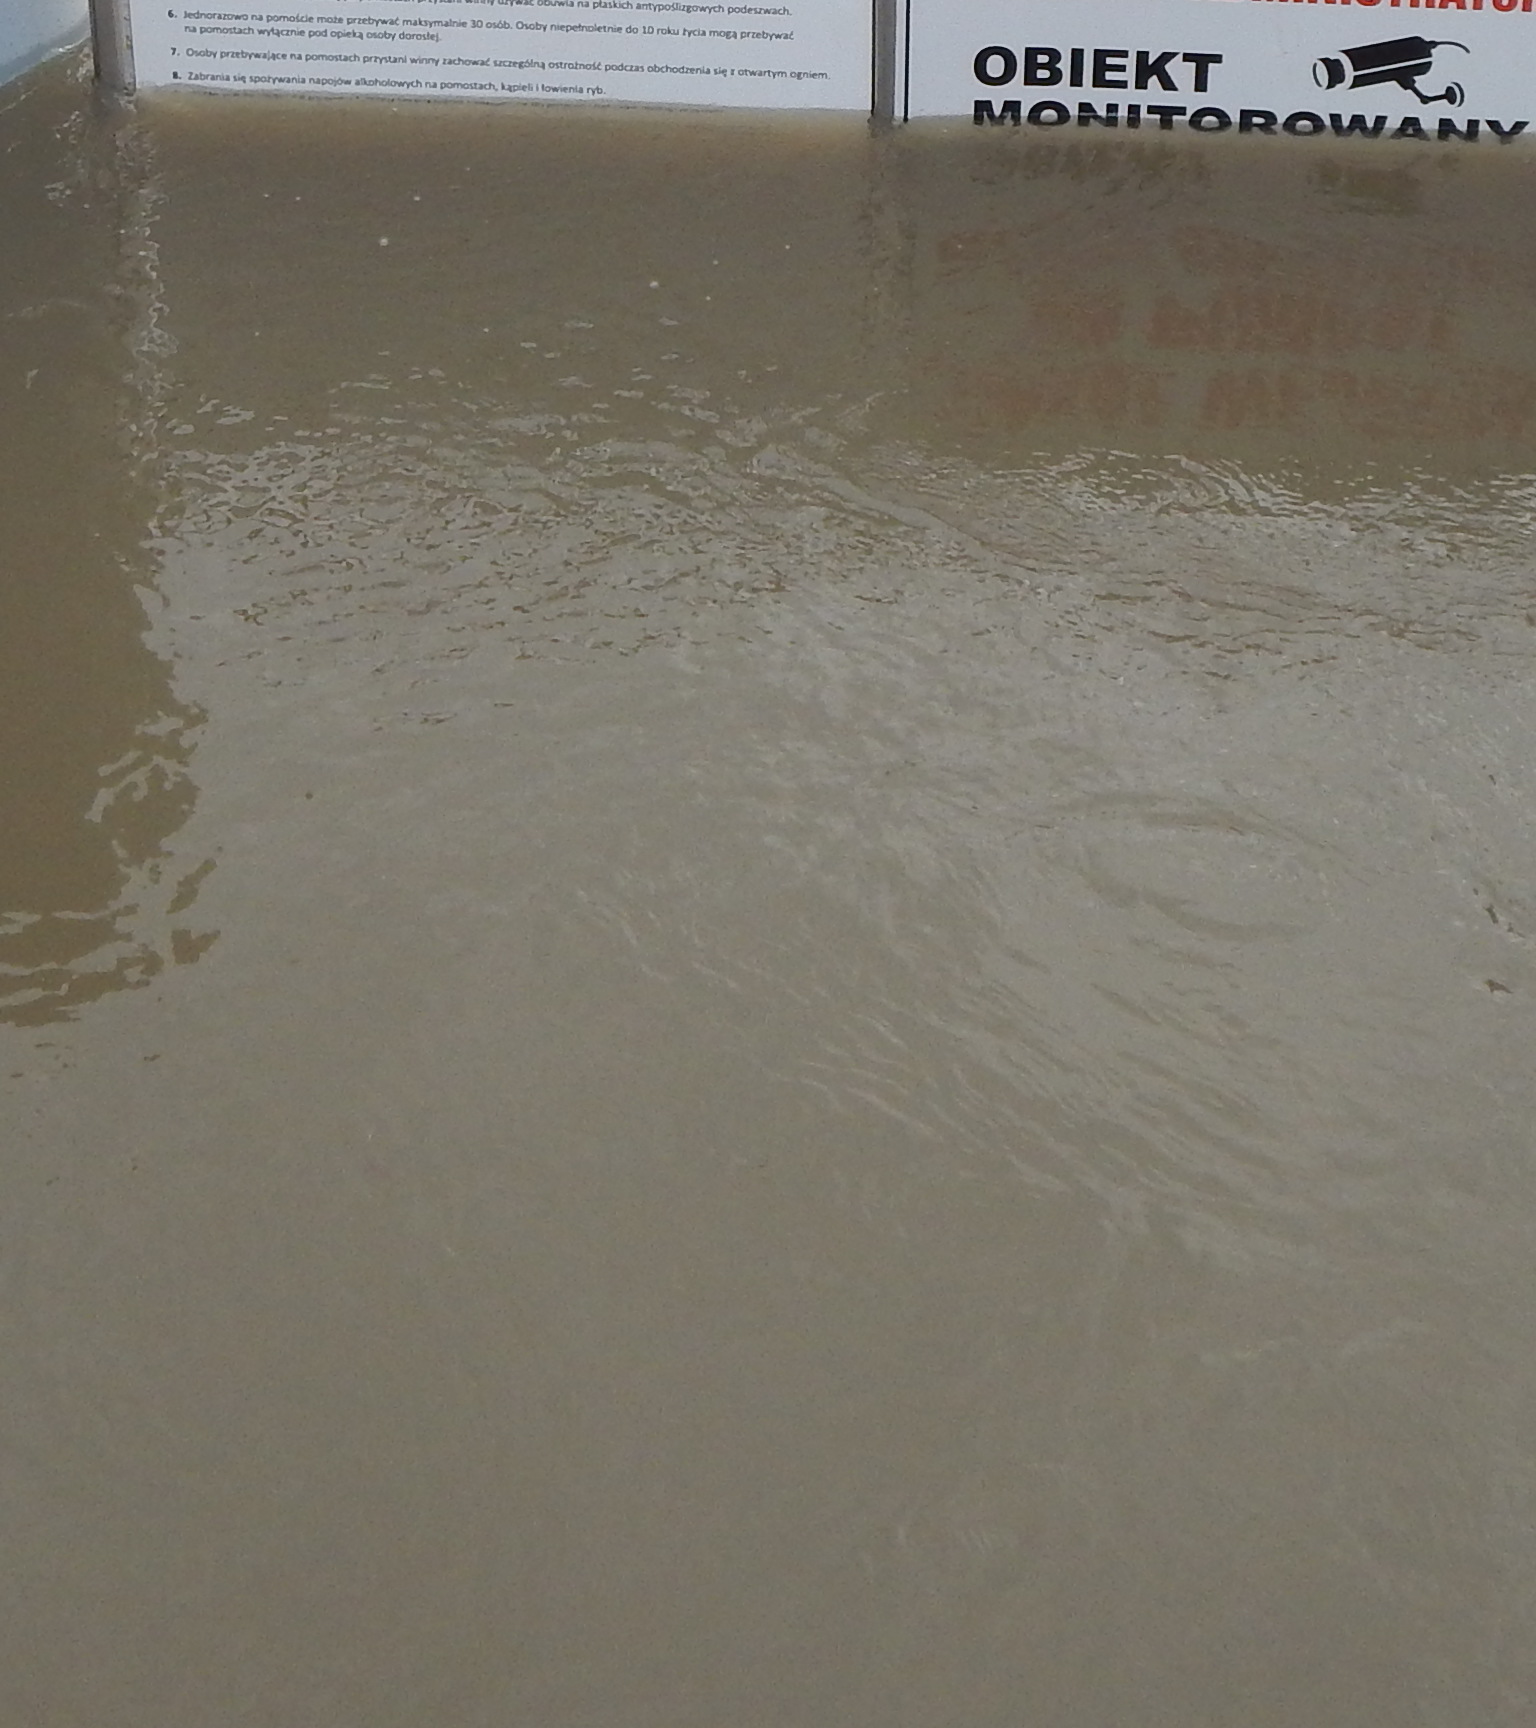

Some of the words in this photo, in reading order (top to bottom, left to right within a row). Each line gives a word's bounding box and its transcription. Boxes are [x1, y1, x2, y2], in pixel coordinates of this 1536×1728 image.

[592, 0, 633, 9] płaskich
[635, 2, 724, 14] antypoślizgowych
[727, 4, 791, 15] podeszwach.
[172, 71, 181, 79] 8.
[188, 71, 230, 81] Zabrania
[233, 73, 245, 83] się
[308, 77, 351, 86] napojów
[354, 77, 422, 88] alkoholowych
[440, 82, 497, 91] pomostach,
[500, 82, 532, 92] kąpieli
[541, 83, 583, 93] łowienia
[586, 85, 605, 95] ryb.
[975, 47, 1223, 93] OBIEKT
[973, 100, 1530, 144] MONITOROWANY
